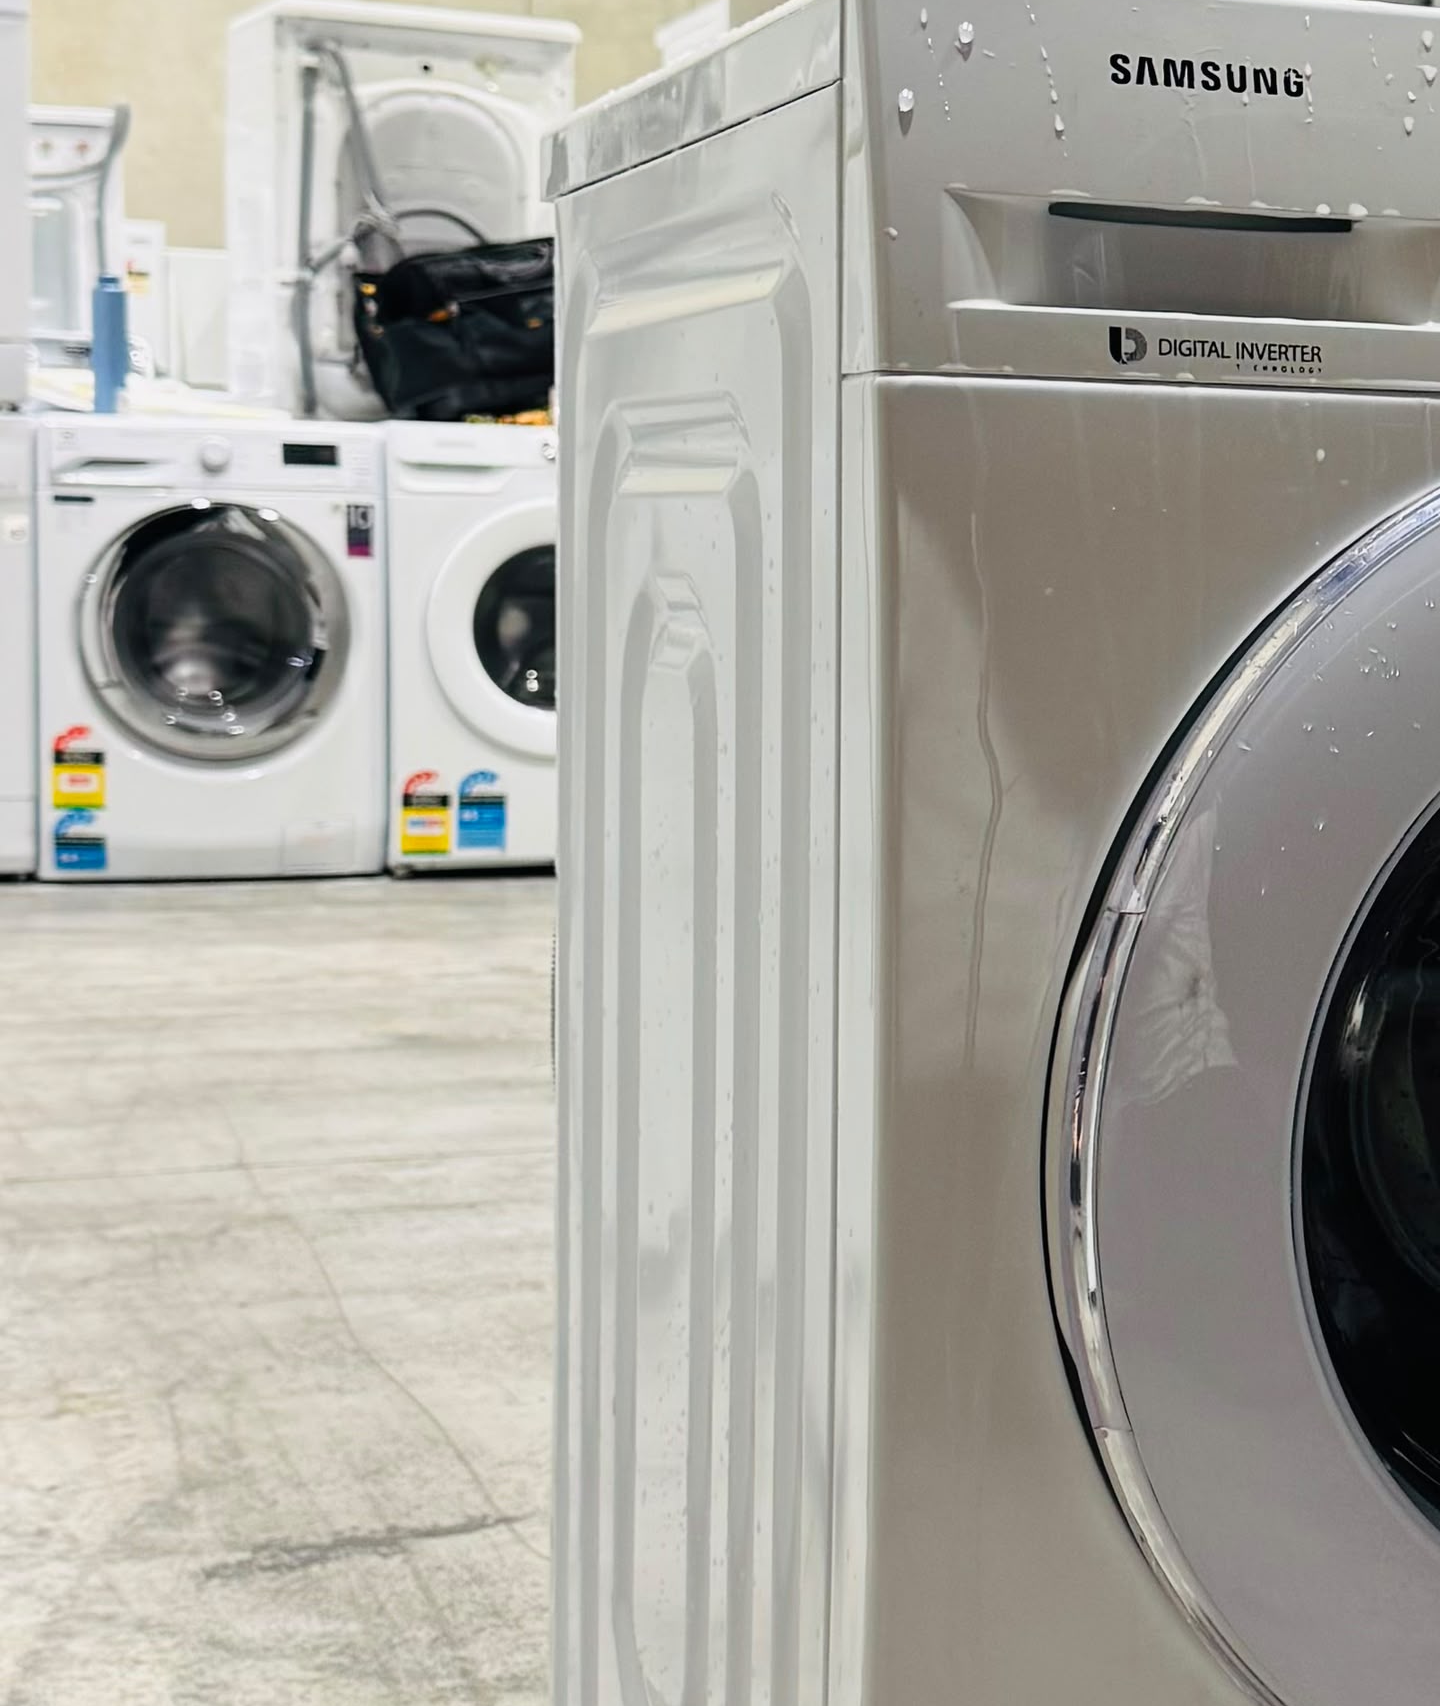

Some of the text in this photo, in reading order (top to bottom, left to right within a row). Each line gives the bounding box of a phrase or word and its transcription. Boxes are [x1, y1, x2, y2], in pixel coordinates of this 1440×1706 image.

[1109, 52, 1305, 98] SAMSUNG
[1158, 338, 1323, 363] DIGITAL INVERTER
